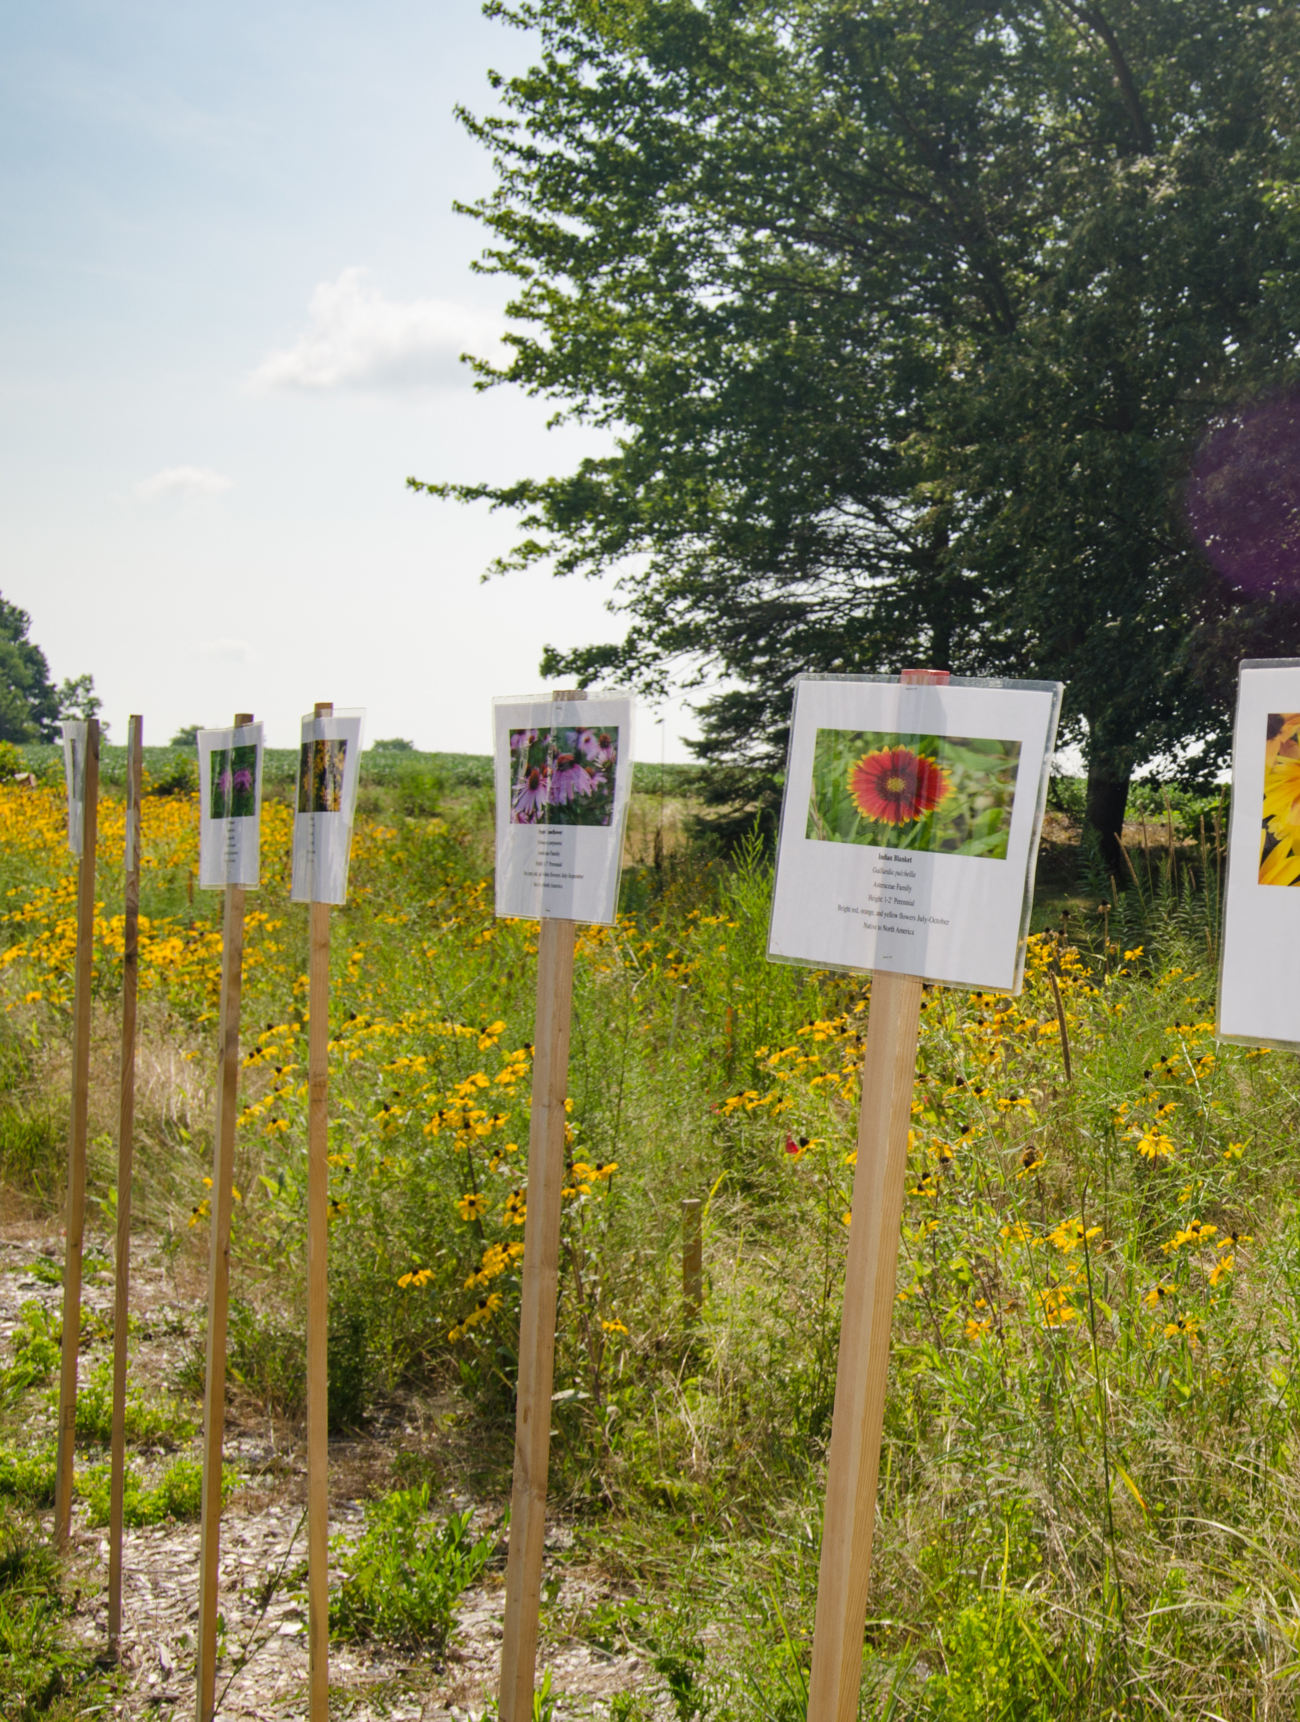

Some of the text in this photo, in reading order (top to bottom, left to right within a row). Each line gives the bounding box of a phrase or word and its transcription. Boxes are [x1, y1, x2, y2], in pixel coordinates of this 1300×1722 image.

[878, 853, 912, 863] Indian Blanket
[896, 884, 912, 893] Family
